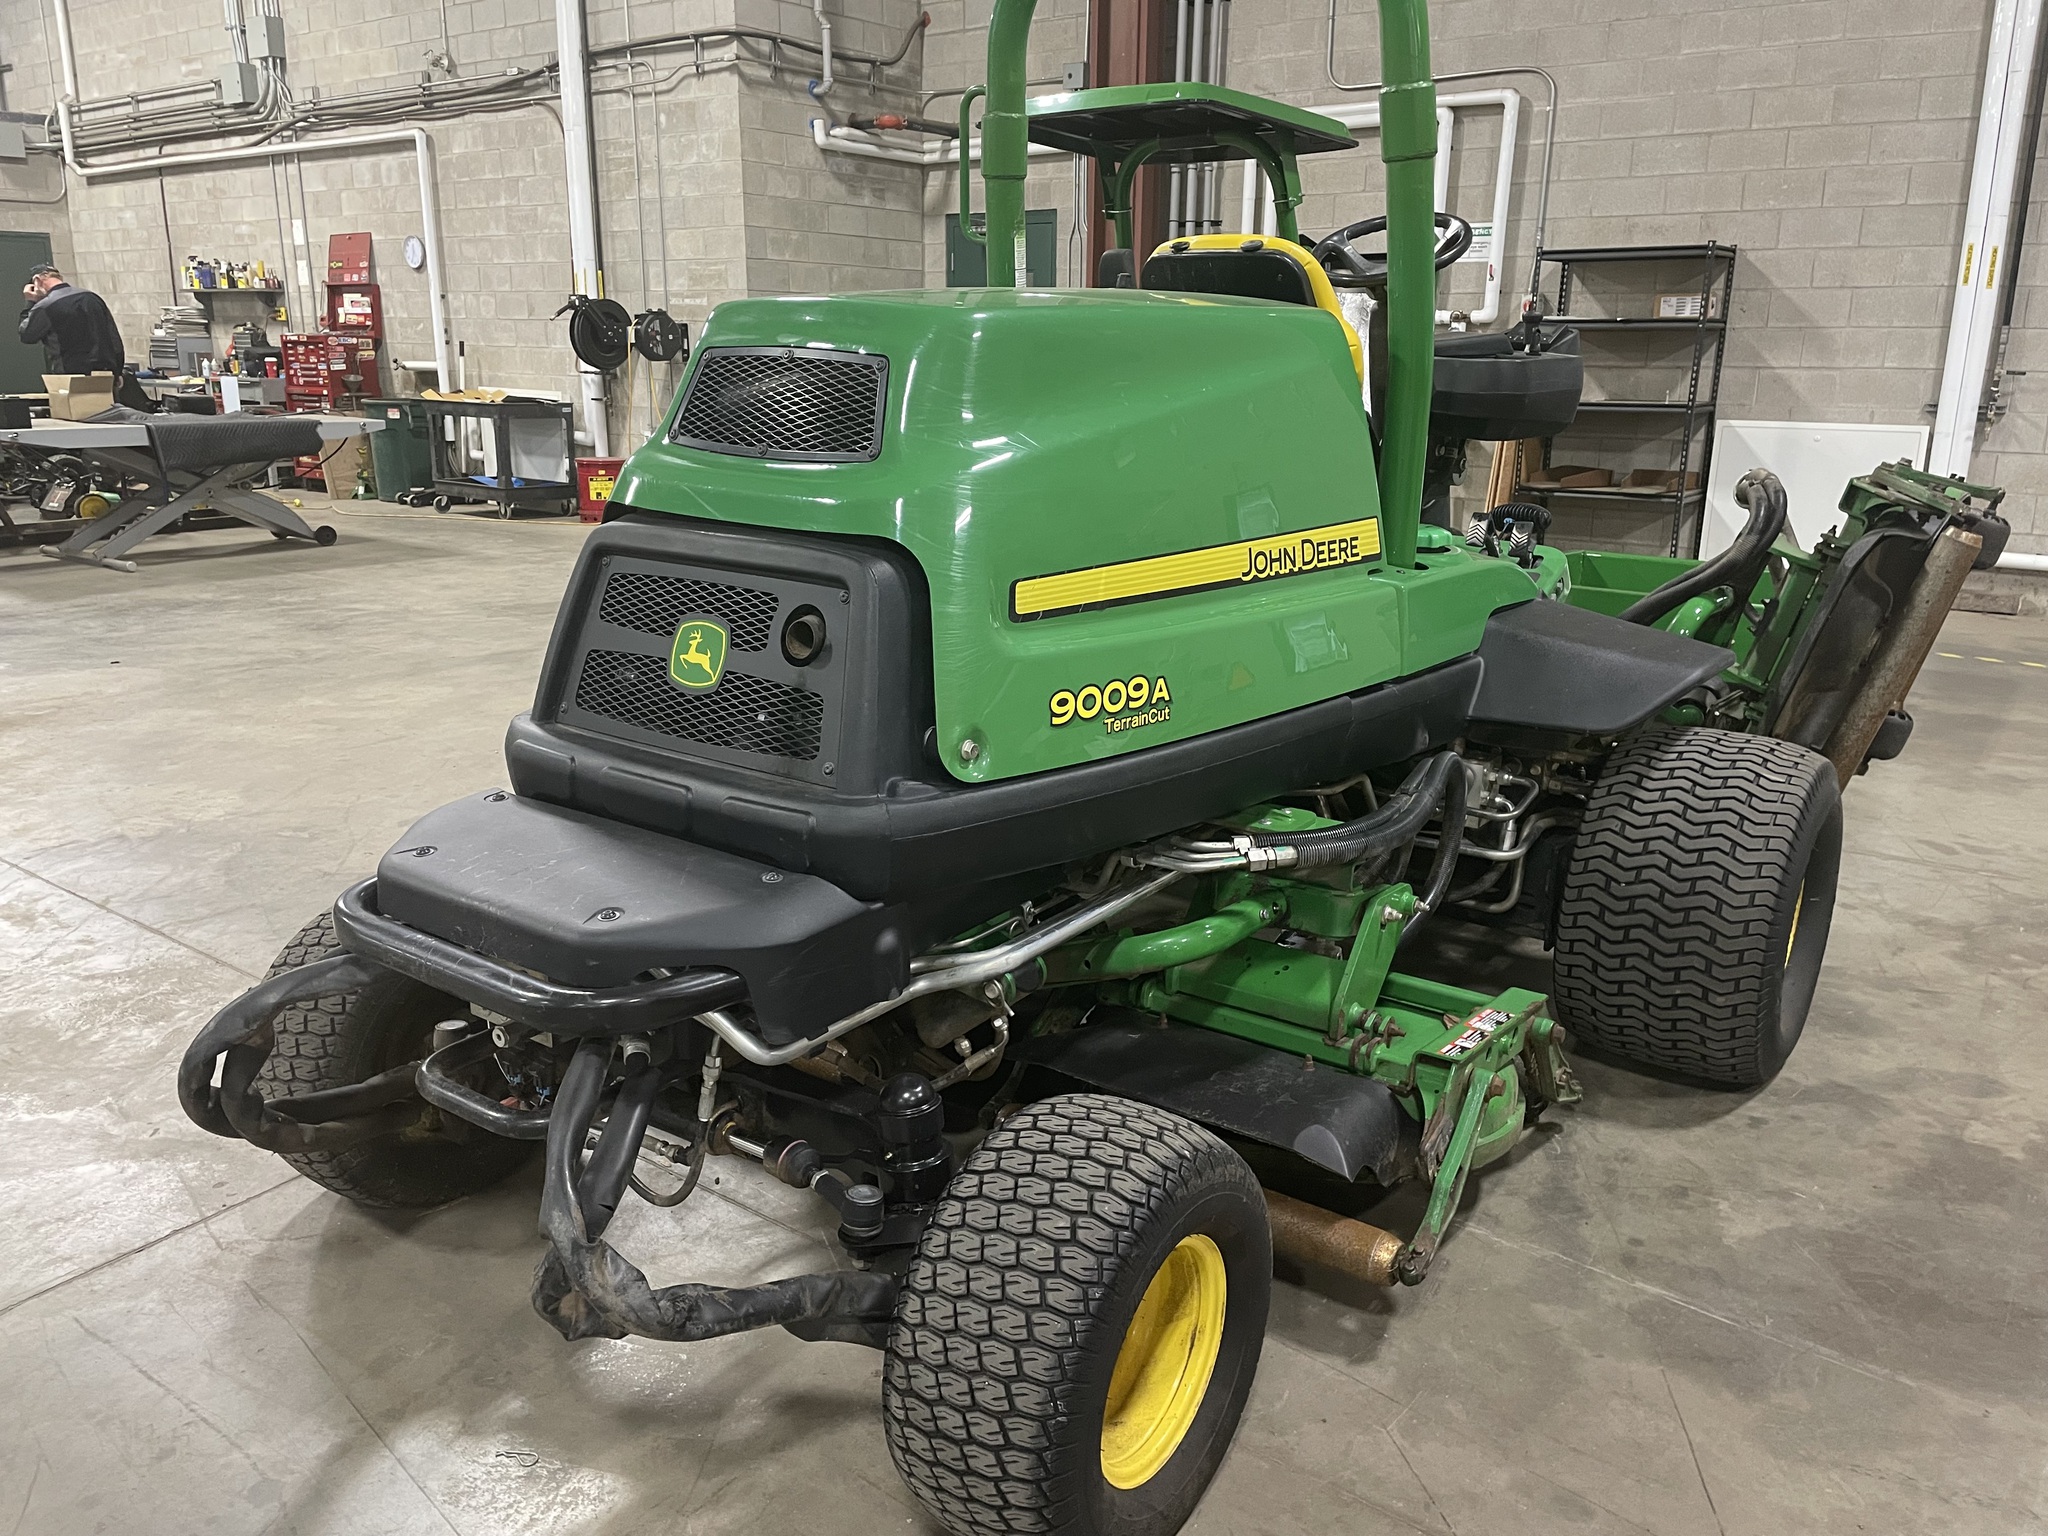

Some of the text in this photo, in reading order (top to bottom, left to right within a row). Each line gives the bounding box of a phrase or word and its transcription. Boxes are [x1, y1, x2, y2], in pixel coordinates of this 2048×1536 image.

[1241, 536, 1361, 578] JOHN DEERE
[1049, 674, 1172, 727] 9009A
[1103, 706, 1171, 734] TerrainCut
